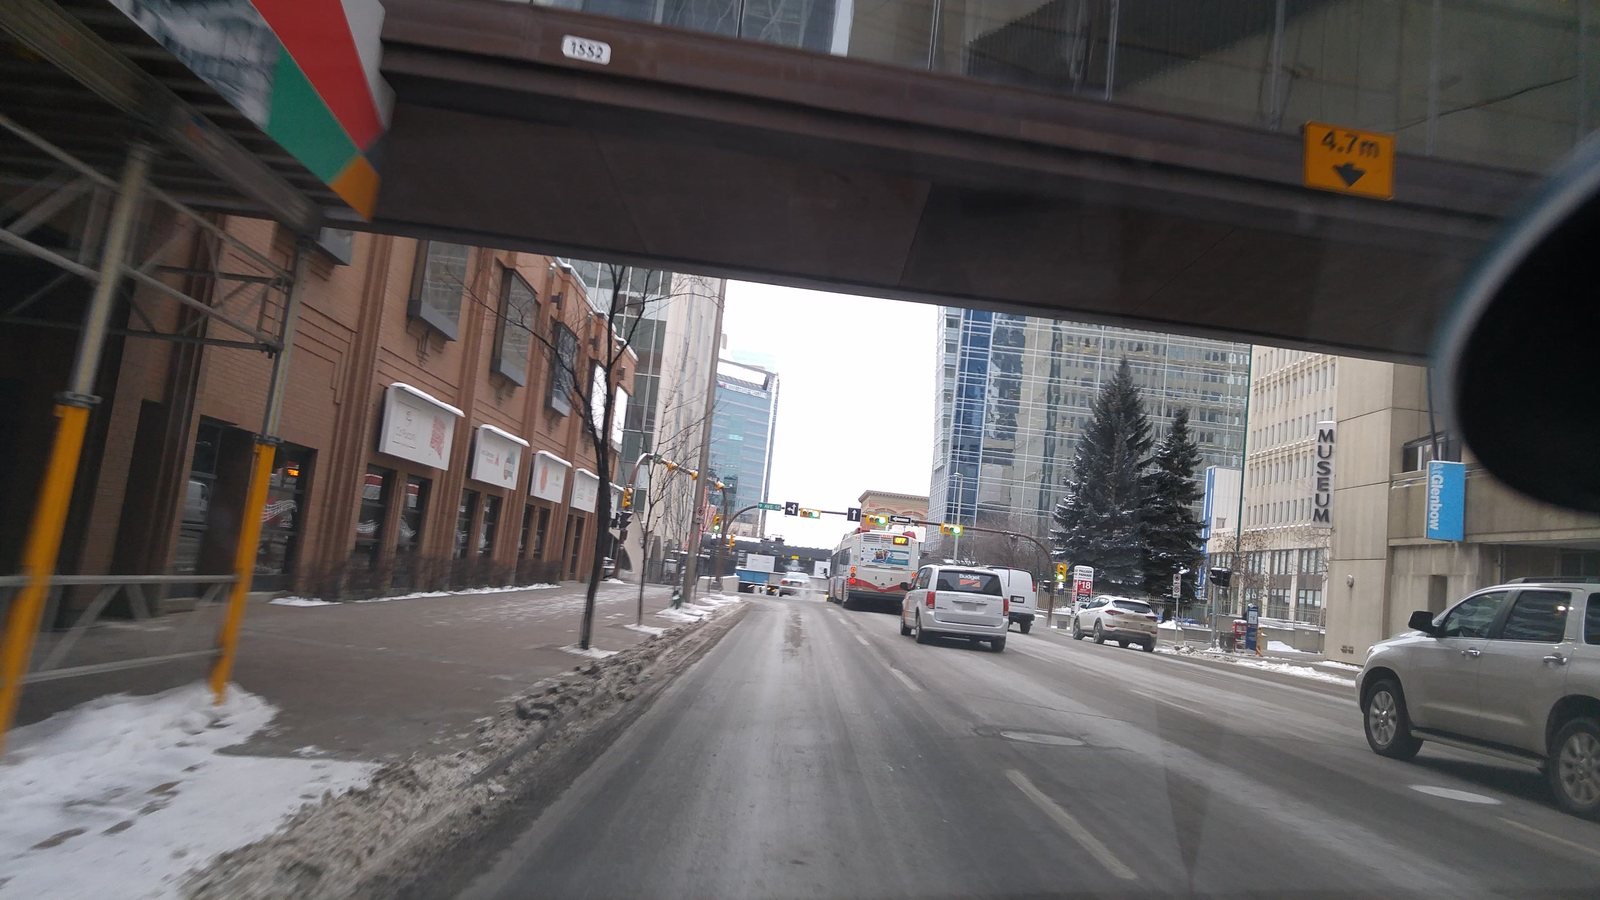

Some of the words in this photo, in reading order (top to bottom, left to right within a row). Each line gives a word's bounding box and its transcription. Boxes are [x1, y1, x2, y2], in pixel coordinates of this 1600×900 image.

[1321, 129, 1380, 158] 4.7m
[1313, 428, 1335, 523] MUSEUM
[1429, 474, 1444, 531] Glenbow
